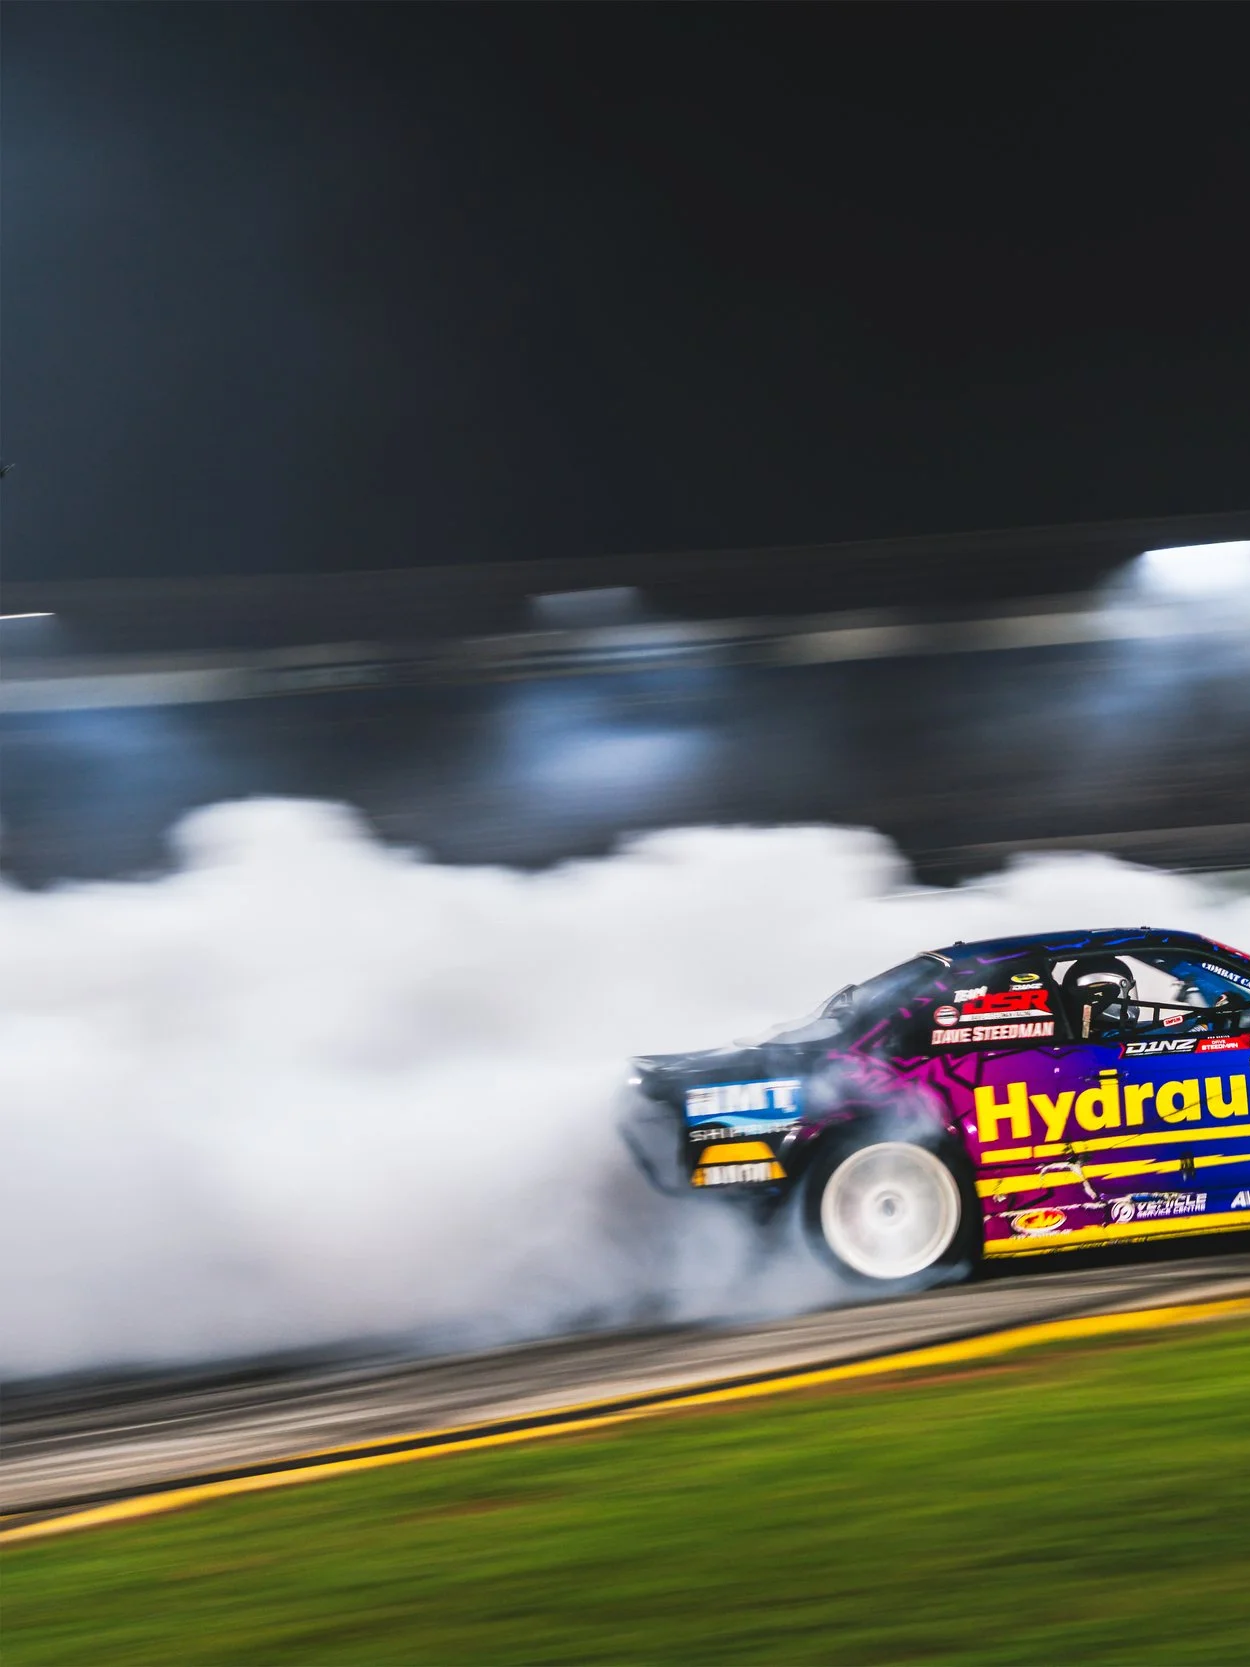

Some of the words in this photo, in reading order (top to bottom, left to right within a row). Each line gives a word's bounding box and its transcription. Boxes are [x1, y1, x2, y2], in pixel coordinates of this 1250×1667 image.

[1201, 962, 1241, 982] COMBAT
[931, 1028, 972, 1045] DAVE
[972, 1021, 1055, 1041] STEEDMAN
[1125, 1038, 1197, 1055] D1NZ
[1201, 1042, 1239, 1051] STEEDMAN
[1136, 1206, 1172, 1219] SERVICE
[1172, 1199, 1207, 1215] CENTRE
